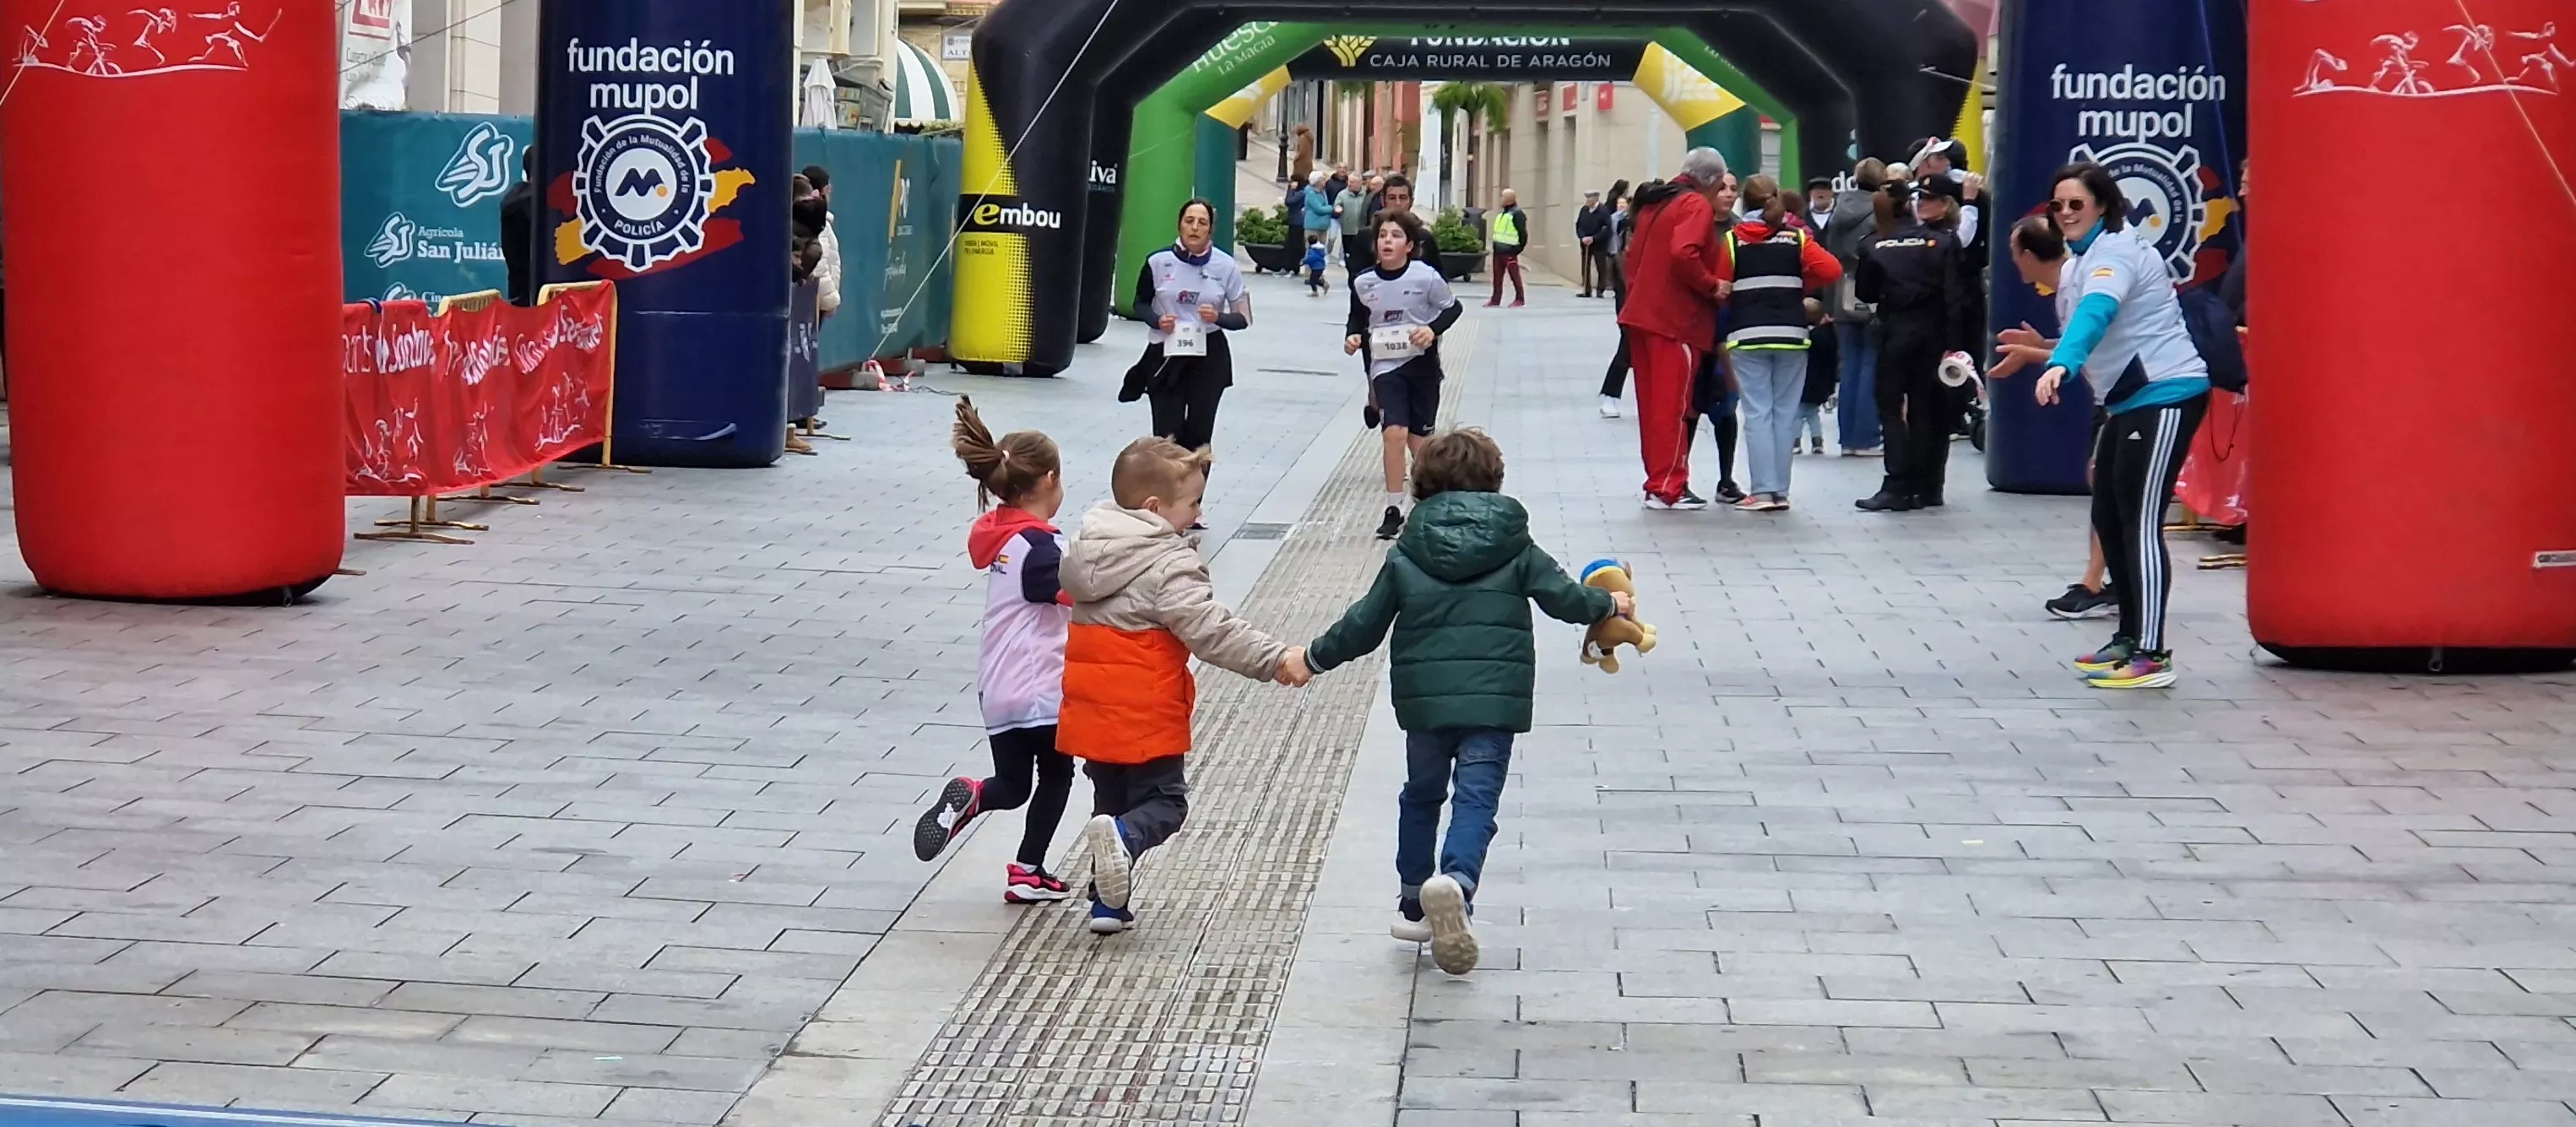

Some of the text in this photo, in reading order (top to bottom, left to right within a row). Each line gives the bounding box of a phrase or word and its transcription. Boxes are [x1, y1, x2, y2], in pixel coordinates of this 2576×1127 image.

[567, 37, 735, 75] fundación
[1369, 51, 1612, 68] CAJA RURAL DE ARAGÓN
[2051, 63, 2226, 101] fundación
[590, 76, 698, 116] mupol
[2078, 103, 2194, 144] mupol
[594, 147, 617, 193] Fundación
[616, 139, 627, 149] de
[628, 135, 638, 144] la
[640, 134, 686, 169] Mutualidad
[680, 170, 690, 182] de
[614, 219, 666, 236] POLICÍA
[973, 203, 1061, 229] embou
[417, 240, 451, 258] San
[1177, 339, 1194, 348] 396
[1384, 342, 1408, 350] 1038
